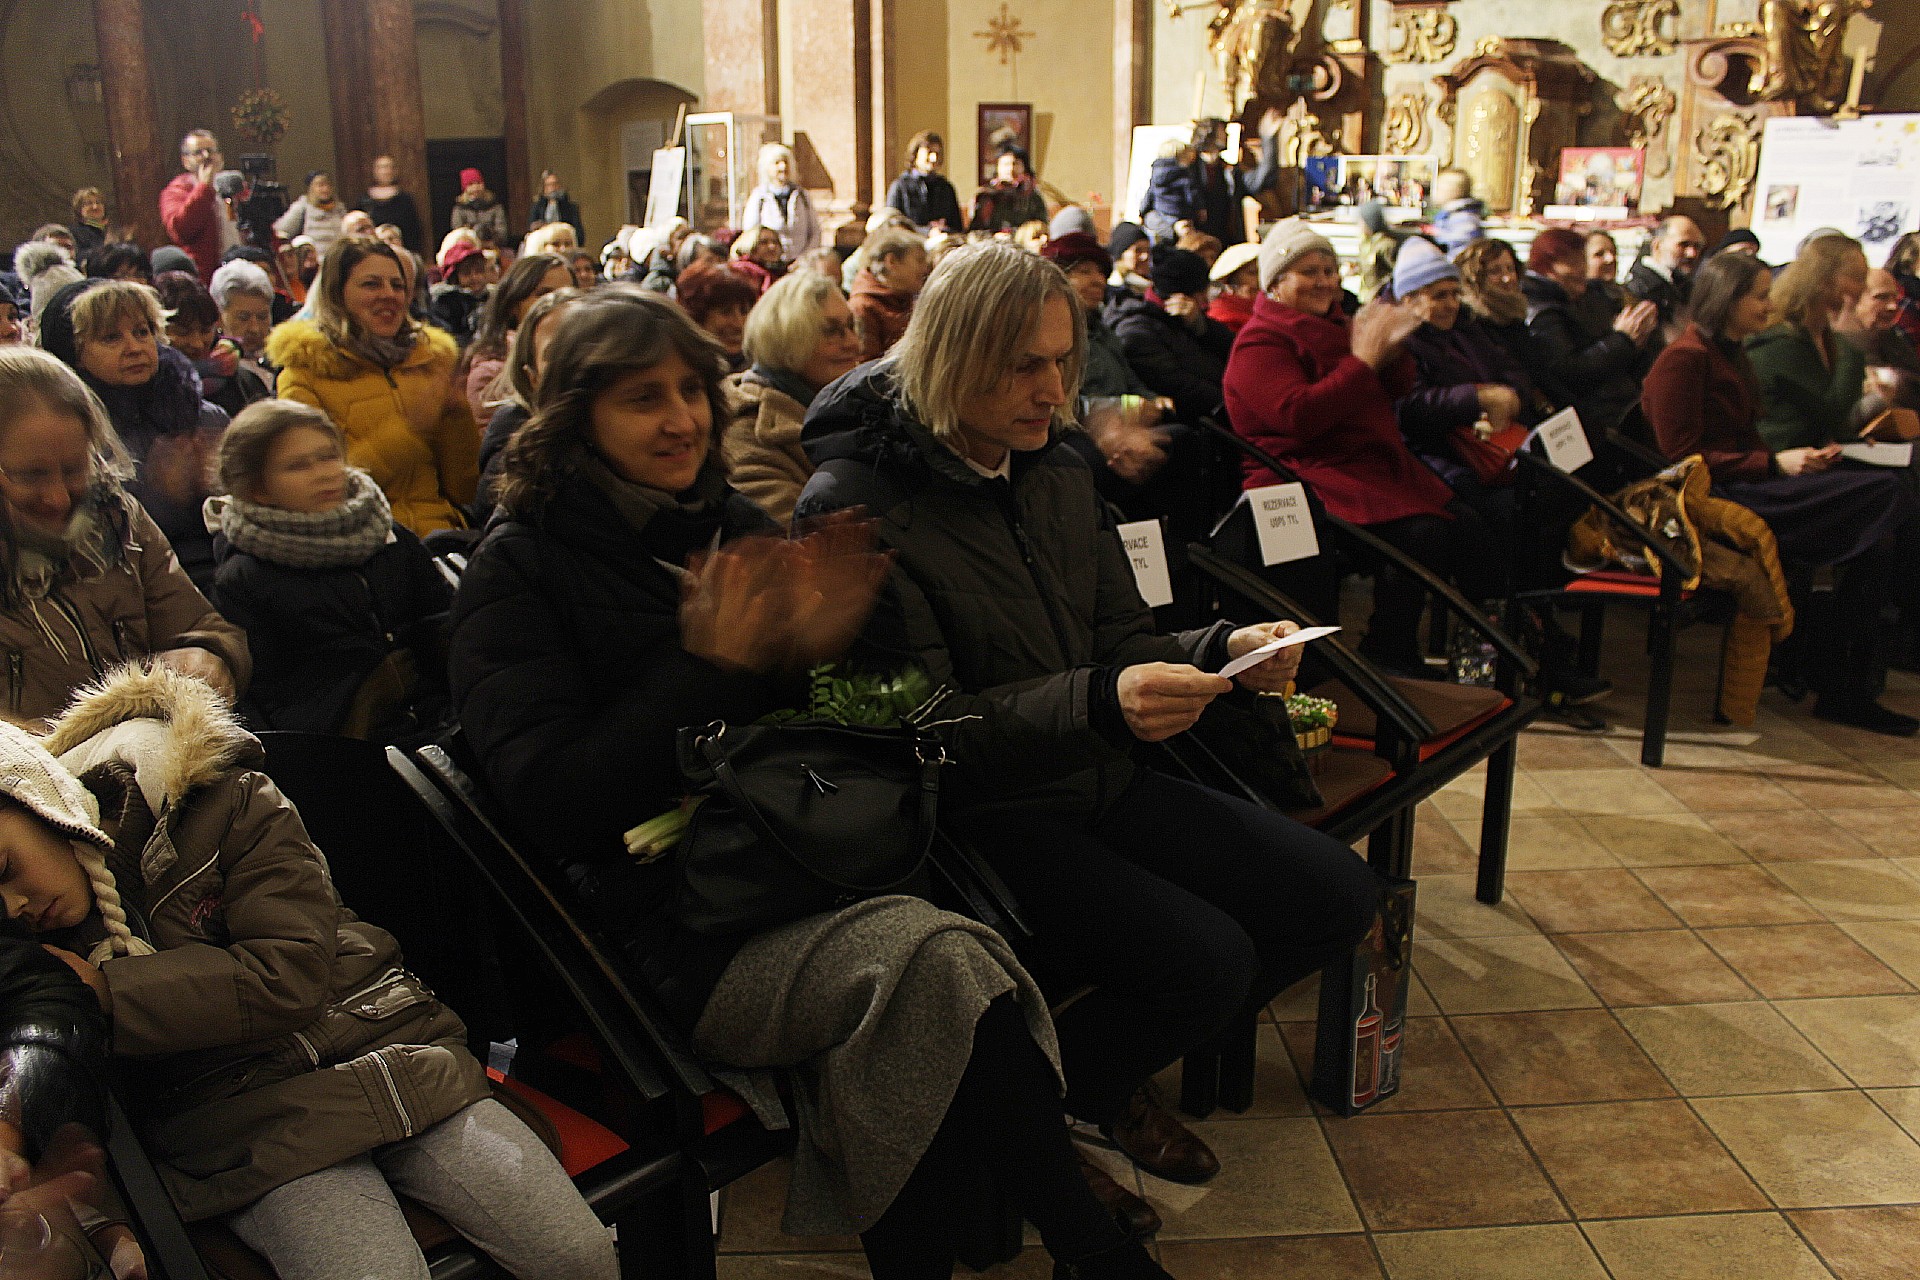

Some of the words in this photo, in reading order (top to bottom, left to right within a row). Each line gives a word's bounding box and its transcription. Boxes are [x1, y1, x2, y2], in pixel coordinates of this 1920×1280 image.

[1263, 495, 1298, 511] REZERVACE
[1123, 535, 1150, 551] RVACE
[1132, 557, 1150, 570] TYL
